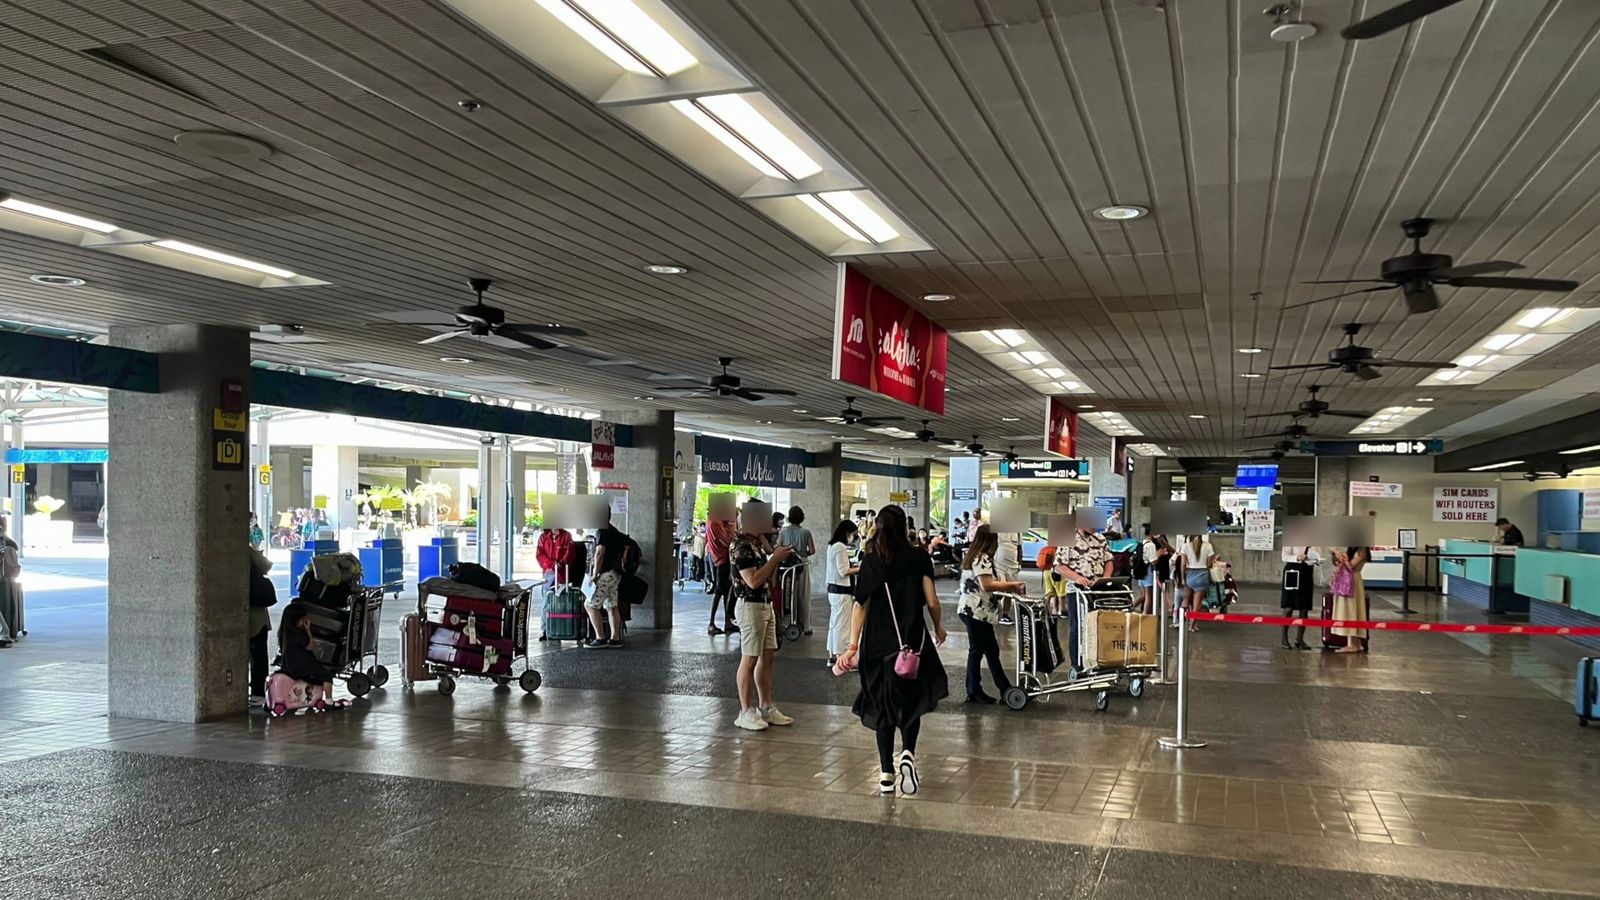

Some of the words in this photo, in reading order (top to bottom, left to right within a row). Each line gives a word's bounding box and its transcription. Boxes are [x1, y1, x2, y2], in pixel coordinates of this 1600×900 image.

[224, 443, 234, 458] D
[1359, 443, 1395, 453] Elevator
[14, 471, 23, 483] H
[261, 472, 269, 484] G
[1442, 488, 1458, 497] SIM
[1461, 489, 1489, 497] CARDS
[1436, 500, 1454, 508] WIFI
[1457, 501, 1495, 509] ROUTERS
[1442, 511, 1463, 520] SOLD
[1465, 512, 1488, 520] HERE
